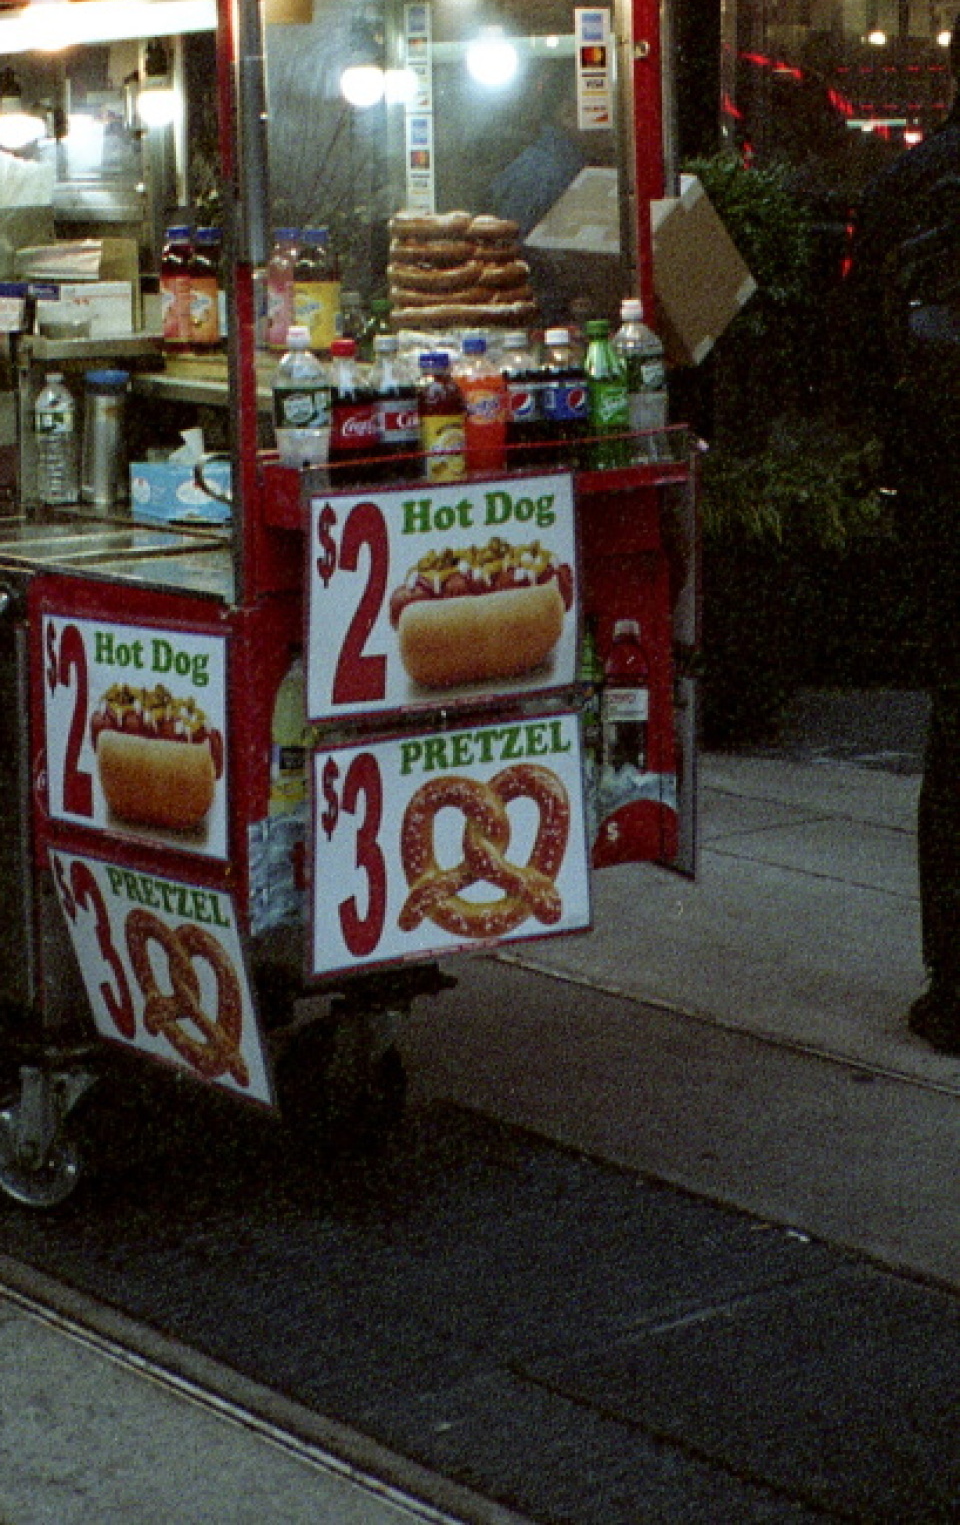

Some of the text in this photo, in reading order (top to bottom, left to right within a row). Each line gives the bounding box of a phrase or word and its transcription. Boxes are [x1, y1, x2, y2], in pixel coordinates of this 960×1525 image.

[400, 490, 556, 535] Hot Dog
[93, 629, 210, 688] Hot Dog
[398, 720, 572, 777] PRETZEL
[104, 865, 230, 928] PRETZEL
